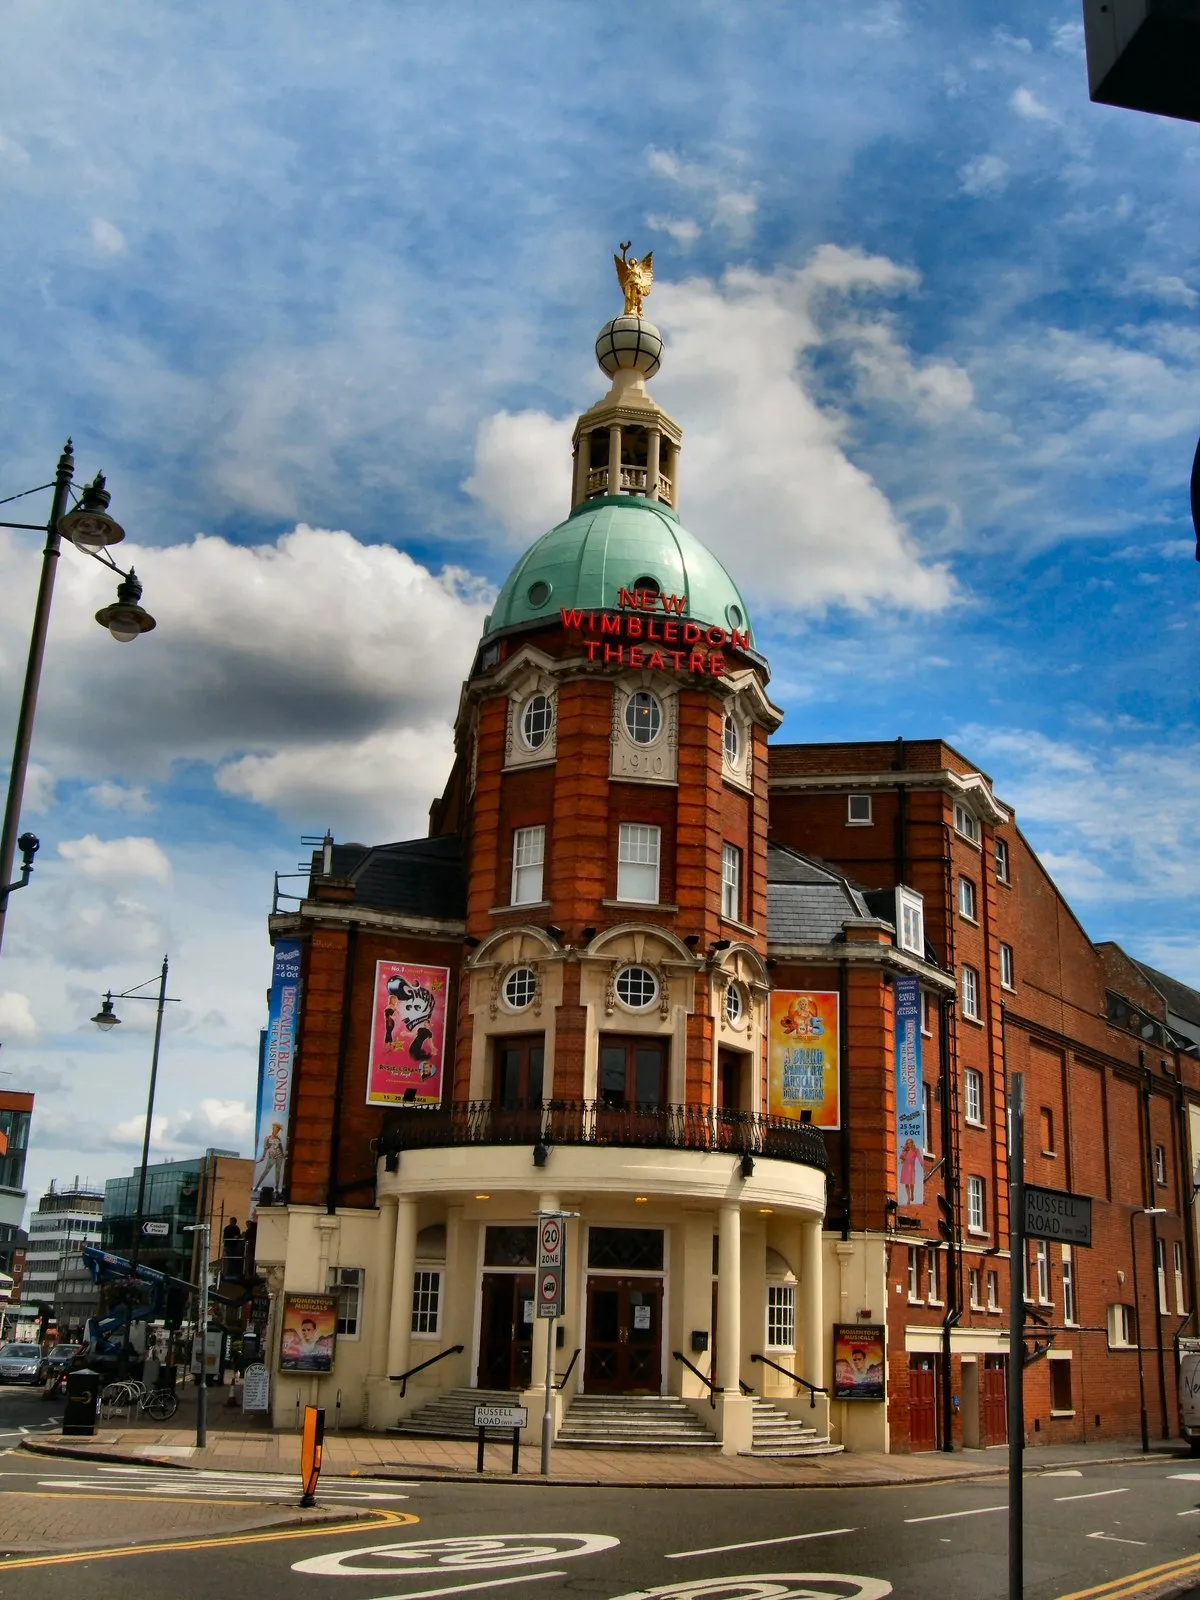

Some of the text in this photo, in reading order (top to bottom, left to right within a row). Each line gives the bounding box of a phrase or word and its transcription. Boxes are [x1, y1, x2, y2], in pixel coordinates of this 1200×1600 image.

[618, 587, 688, 616] NEW
[559, 607, 750, 651] WIMBLEDON
[582, 640, 726, 677] THEATRE
[620, 754, 665, 775] 1910
[286, 964, 299, 972] Sep
[780, 1015, 798, 1034] 9
[810, 1015, 825, 1035] 5
[268, 1020, 280, 1078] THE MUSICAL
[273, 985, 297, 1112] LEGALLY BLONDE
[906, 1020, 916, 1063] LEGALLY
[792, 1048, 824, 1065] BRAND
[907, 1065, 917, 1106] BLONDE
[1027, 1193, 1076, 1218] RUSSELL
[1027, 1213, 1060, 1234] ROAD
[544, 1230, 558, 1242] 20
[542, 1254, 559, 1264] ZONE
[290, 1297, 334, 1306] MOMENTOUS
[478, 1408, 513, 1416] RUSSELL
[478, 1417, 501, 1425] ROAD
[371, 1540, 557, 1564] 20
